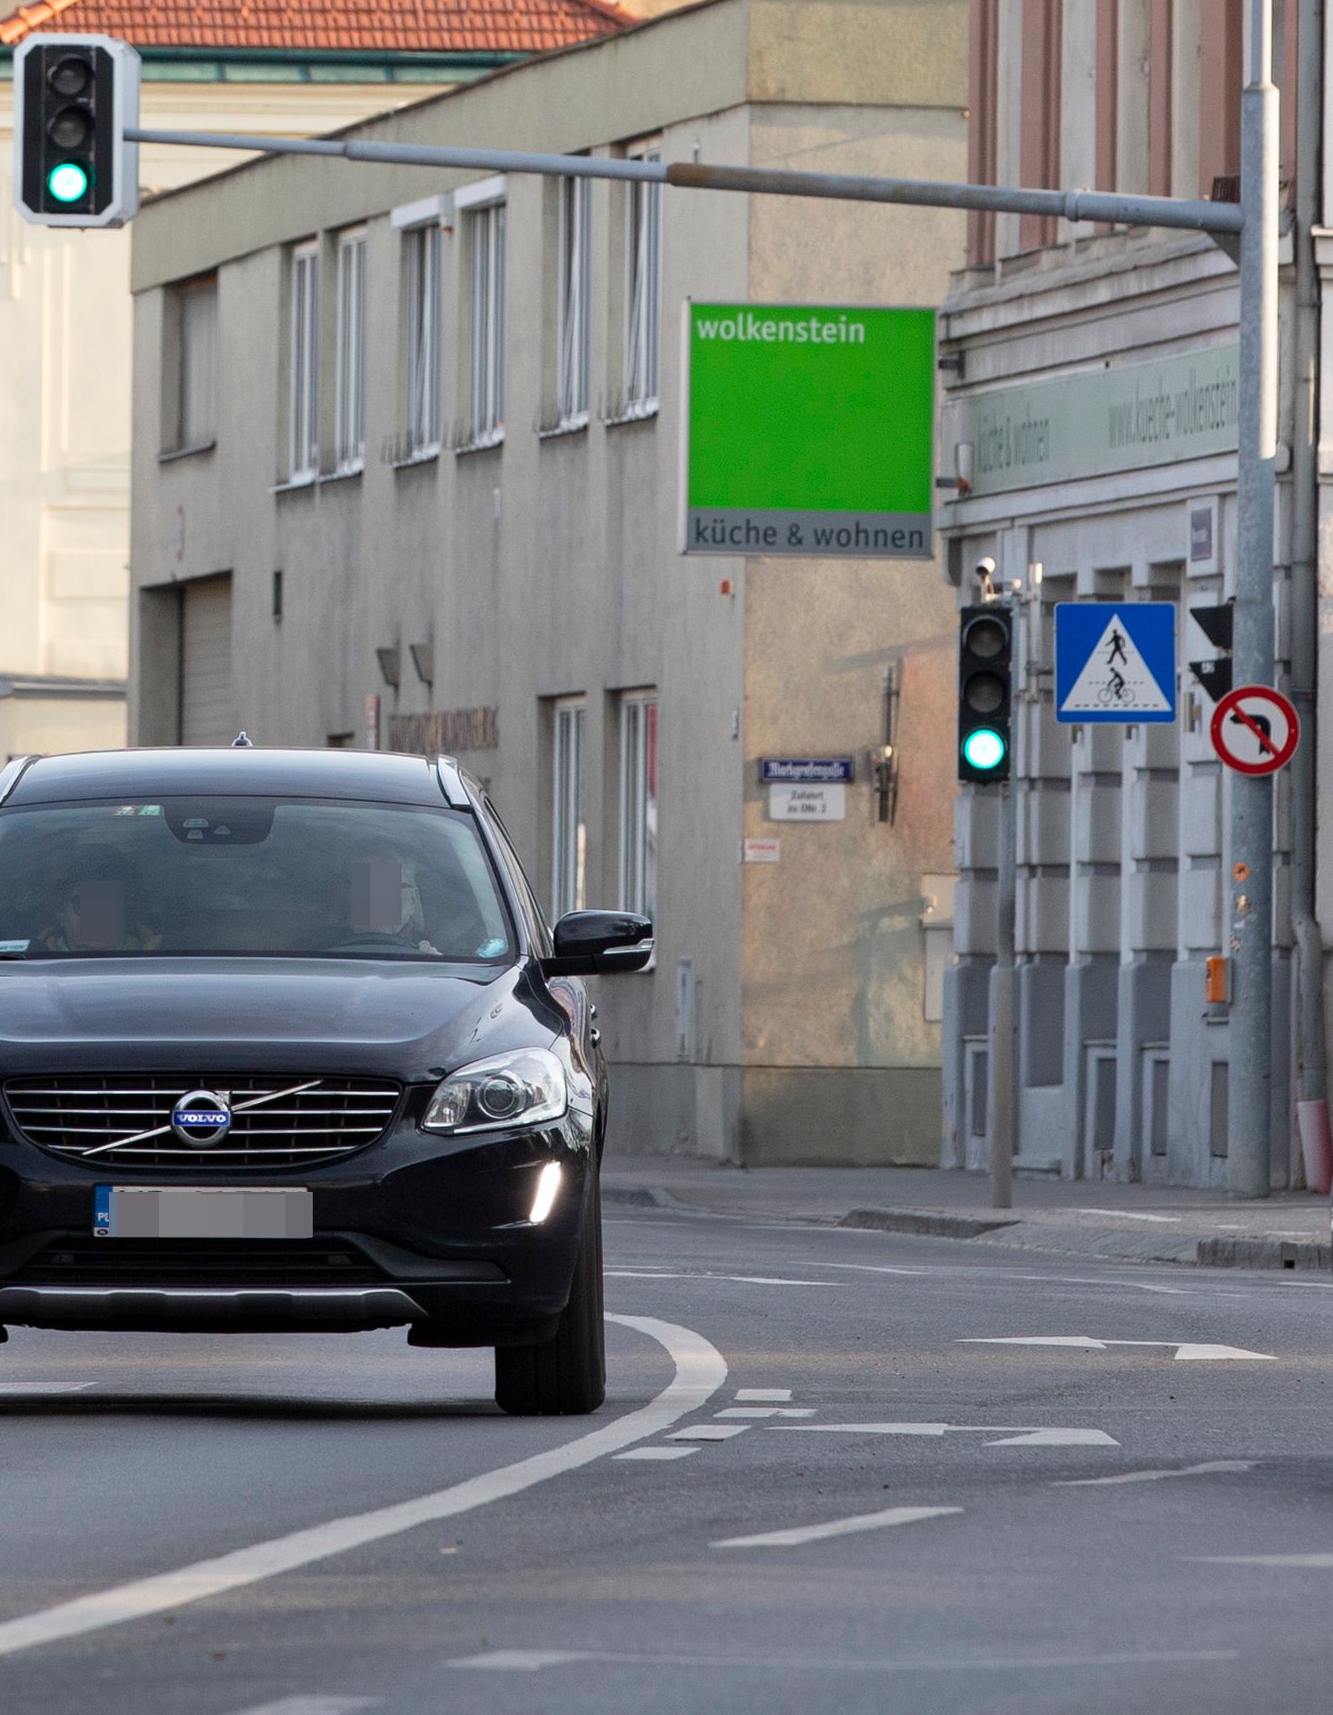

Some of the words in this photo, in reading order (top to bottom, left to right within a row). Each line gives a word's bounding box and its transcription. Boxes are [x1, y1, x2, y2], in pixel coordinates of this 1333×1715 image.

[697, 312, 866, 344] wolkenstein
[695, 518, 778, 545] küche
[788, 523, 804, 546] &
[813, 522, 924, 549] wohnen
[177, 1113, 227, 1123] VOLVO
